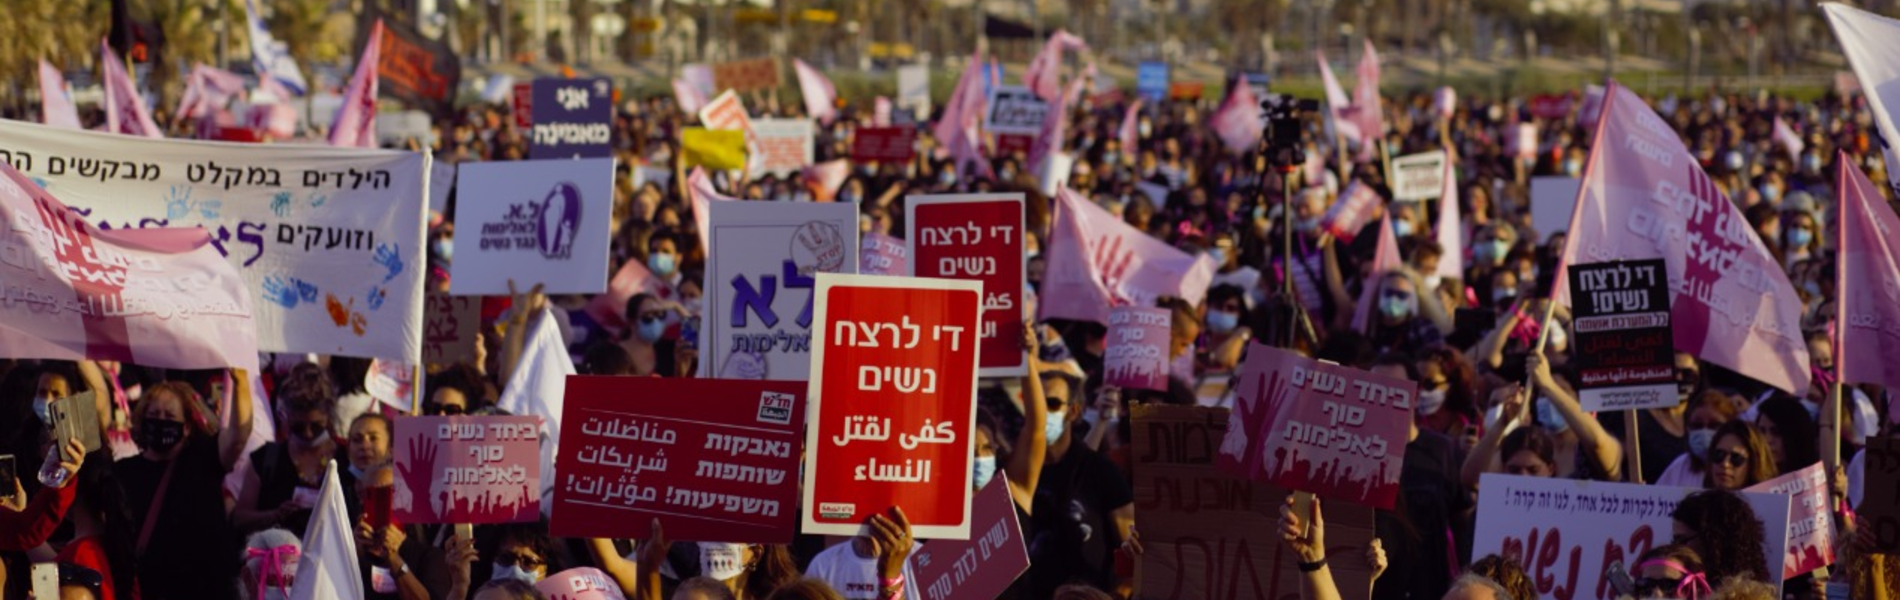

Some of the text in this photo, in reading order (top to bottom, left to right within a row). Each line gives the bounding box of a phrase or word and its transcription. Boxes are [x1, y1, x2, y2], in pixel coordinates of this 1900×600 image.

[556, 87, 590, 111] אני
[533, 121, 611, 146] מאמינה
[47, 155, 161, 183] מבקשים
[186, 160, 281, 191] במקלט
[302, 167, 391, 190] הילדים
[276, 223, 373, 252] וזועקים
[481, 220, 536, 235] לאלימות
[920, 220, 1014, 246] די לרצח
[480, 236, 537, 250] נגד נשים
[938, 256, 997, 276] נשים
[1579, 263, 1655, 291] די לרצח
[982, 291, 1014, 315] كف
[1591, 289, 1649, 313] נשים!
[834, 315, 920, 349] לרצח
[1133, 311, 1171, 327] ביחד
[731, 328, 813, 353] אלימות
[933, 325, 964, 351] די
[1117, 327, 1144, 344] סוף
[858, 365, 936, 393] נשים
[1291, 365, 1410, 409] ביחד נשים
[1322, 400, 1366, 427] סוף
[437, 423, 537, 440] ביחד נשים
[581, 416, 677, 445] مناضلات
[832, 415, 956, 450] كفى لقتل
[1283, 419, 1388, 459] לאלימות
[469, 445, 504, 466] סוף
[704, 432, 790, 458] נאבקות
[577, 445, 667, 474] شريكات
[695, 459, 786, 485] שותפות
[854, 457, 931, 483] النساء
[443, 464, 527, 484] לאלימות
[566, 474, 656, 505] مؤثرات!
[666, 486, 779, 517] משפיעות!
[1513, 489, 1535, 511] קרה
[1538, 491, 1551, 508] זה
[1555, 489, 1569, 511] לנו
[1600, 493, 1620, 514] לכל
[1621, 494, 1655, 518] לקרות
[977, 516, 1009, 561] נשים
[953, 546, 977, 586] לזה
